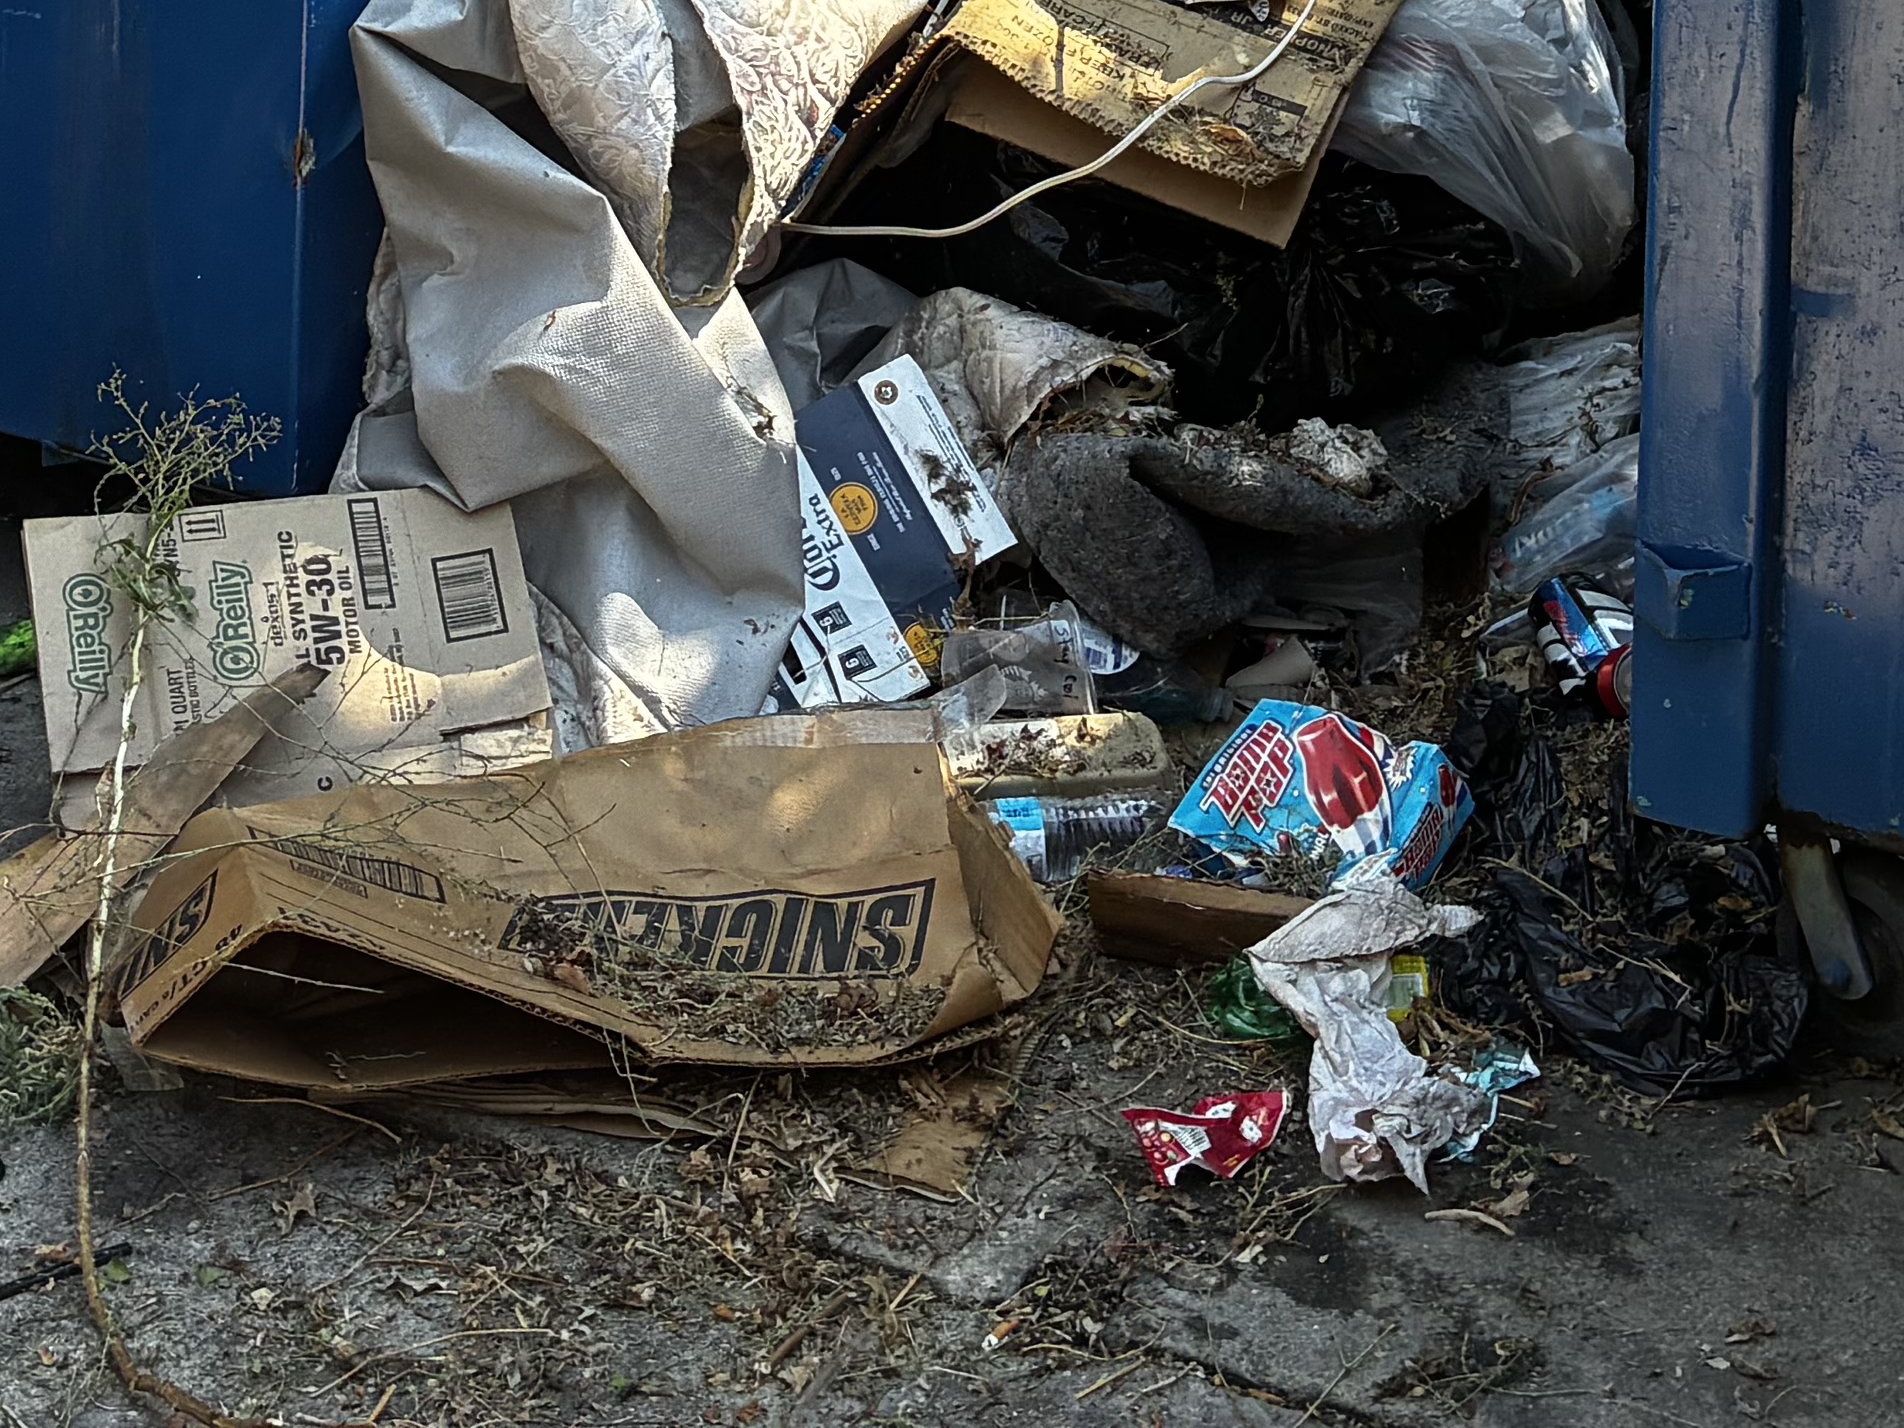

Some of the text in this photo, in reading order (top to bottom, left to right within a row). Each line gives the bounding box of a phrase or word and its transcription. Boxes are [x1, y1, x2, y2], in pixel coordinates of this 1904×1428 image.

[1012, 15, 1077, 57] FOZEN
[1080, 56, 1126, 82] KEEP
[802, 516, 841, 591] Cor
[808, 493, 844, 554] Extra
[209, 561, 260, 680] O'Reilly
[278, 530, 308, 642] SYNTHETIC
[302, 555, 345, 666] 5W-30
[337, 565, 362, 654] MOTOR OIL
[819, 618, 833, 627] 6
[63, 573, 113, 694] O'Reilly
[845, 658, 859, 669] 6
[166, 668, 187, 714] QUART
[524, 893, 916, 974] SNICKE
